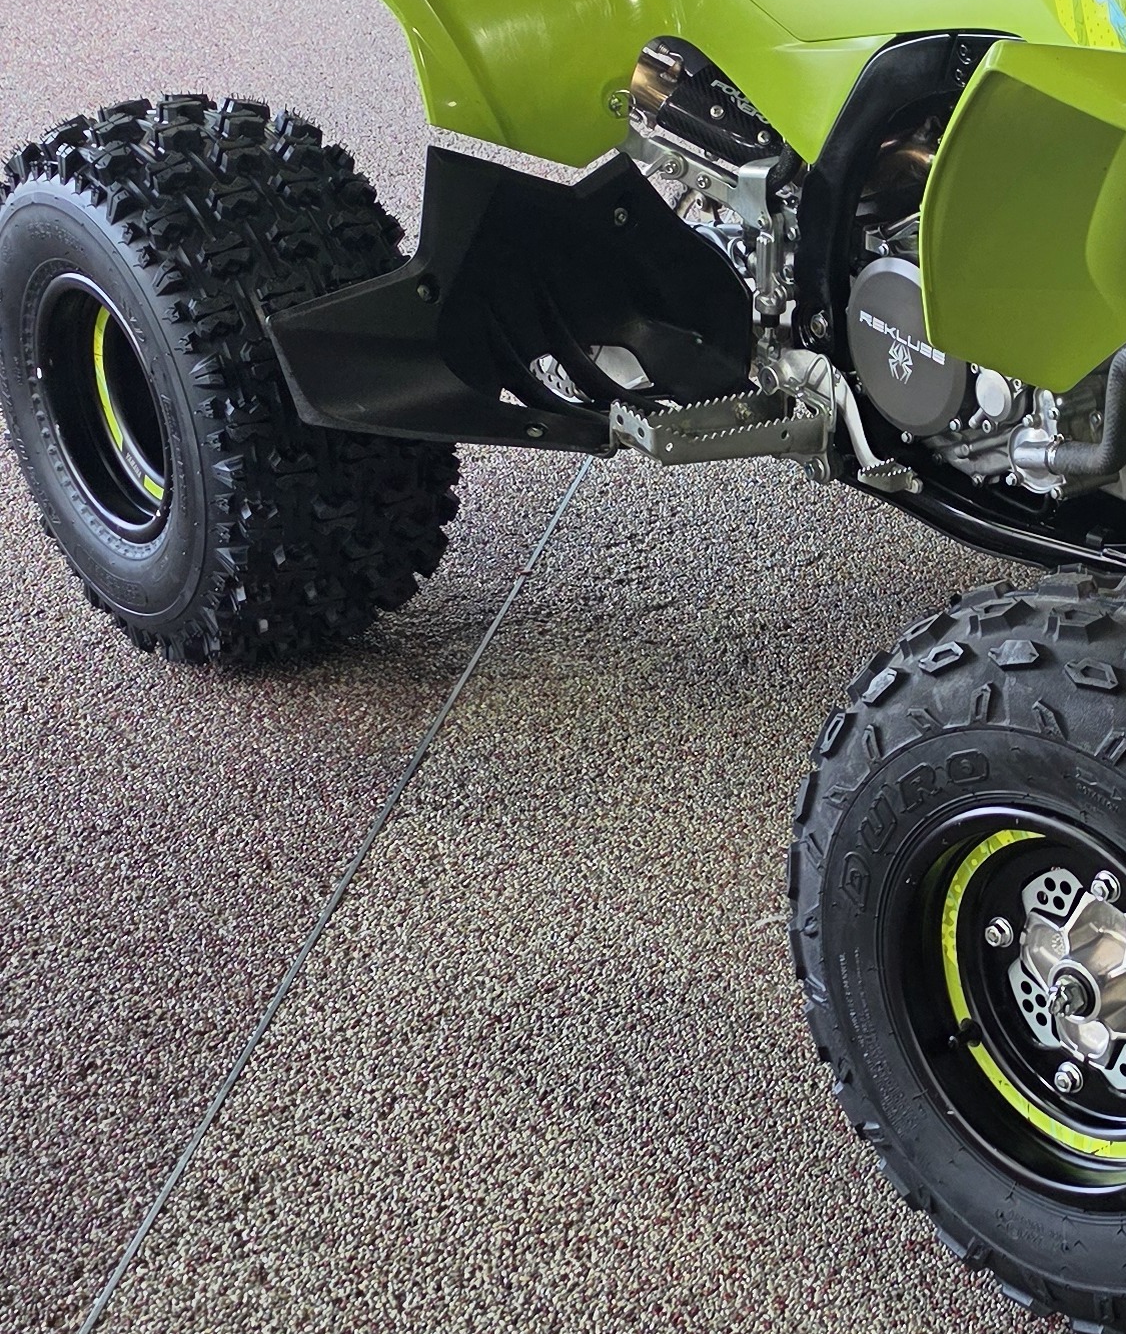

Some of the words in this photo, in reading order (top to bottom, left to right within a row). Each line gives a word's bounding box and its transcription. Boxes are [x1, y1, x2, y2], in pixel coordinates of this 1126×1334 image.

[710, 79, 750, 104] FOU
[859, 310, 946, 366] REKLUSE
[839, 748, 990, 914] DURO
